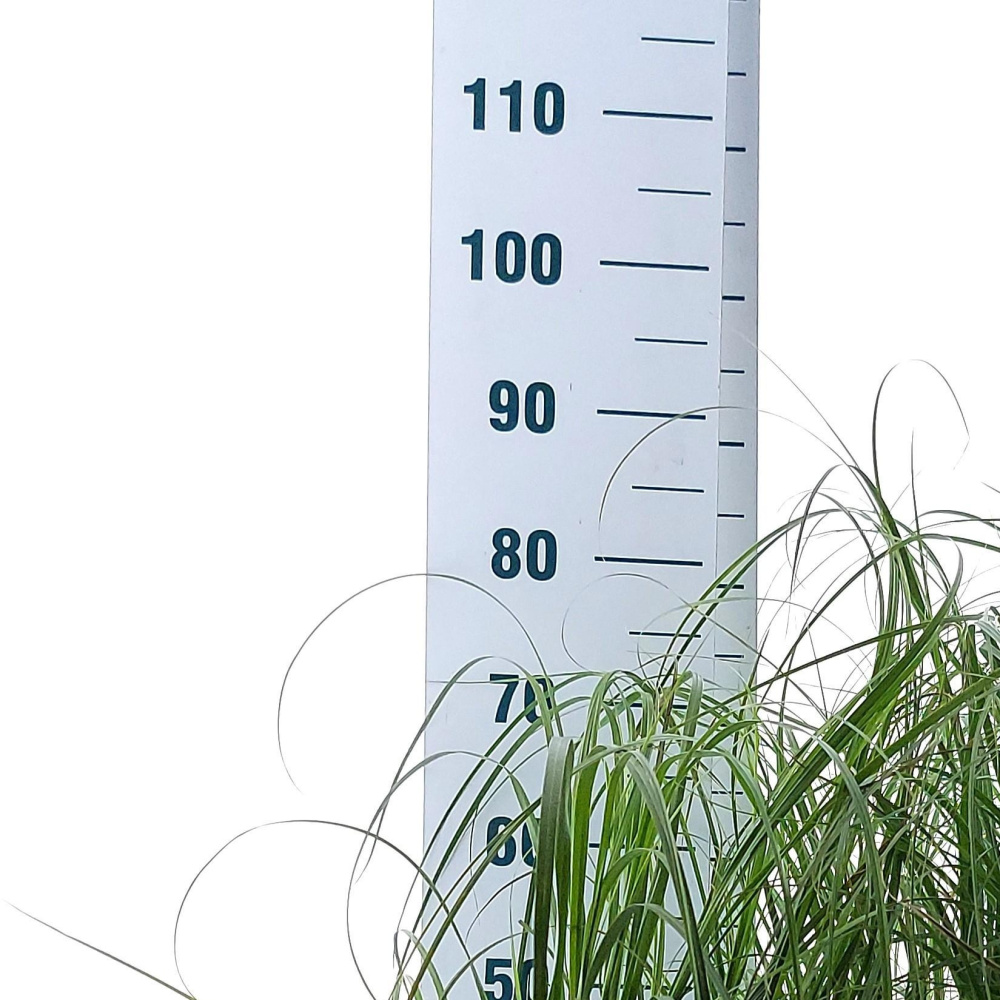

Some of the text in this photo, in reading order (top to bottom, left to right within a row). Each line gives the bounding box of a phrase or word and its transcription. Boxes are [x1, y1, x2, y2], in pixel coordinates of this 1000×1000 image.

[463, 77, 565, 136] 110
[461, 229, 562, 286] 100
[488, 380, 556, 434] 90
[490, 528, 558, 581] 80
[489, 673, 555, 724] 70
